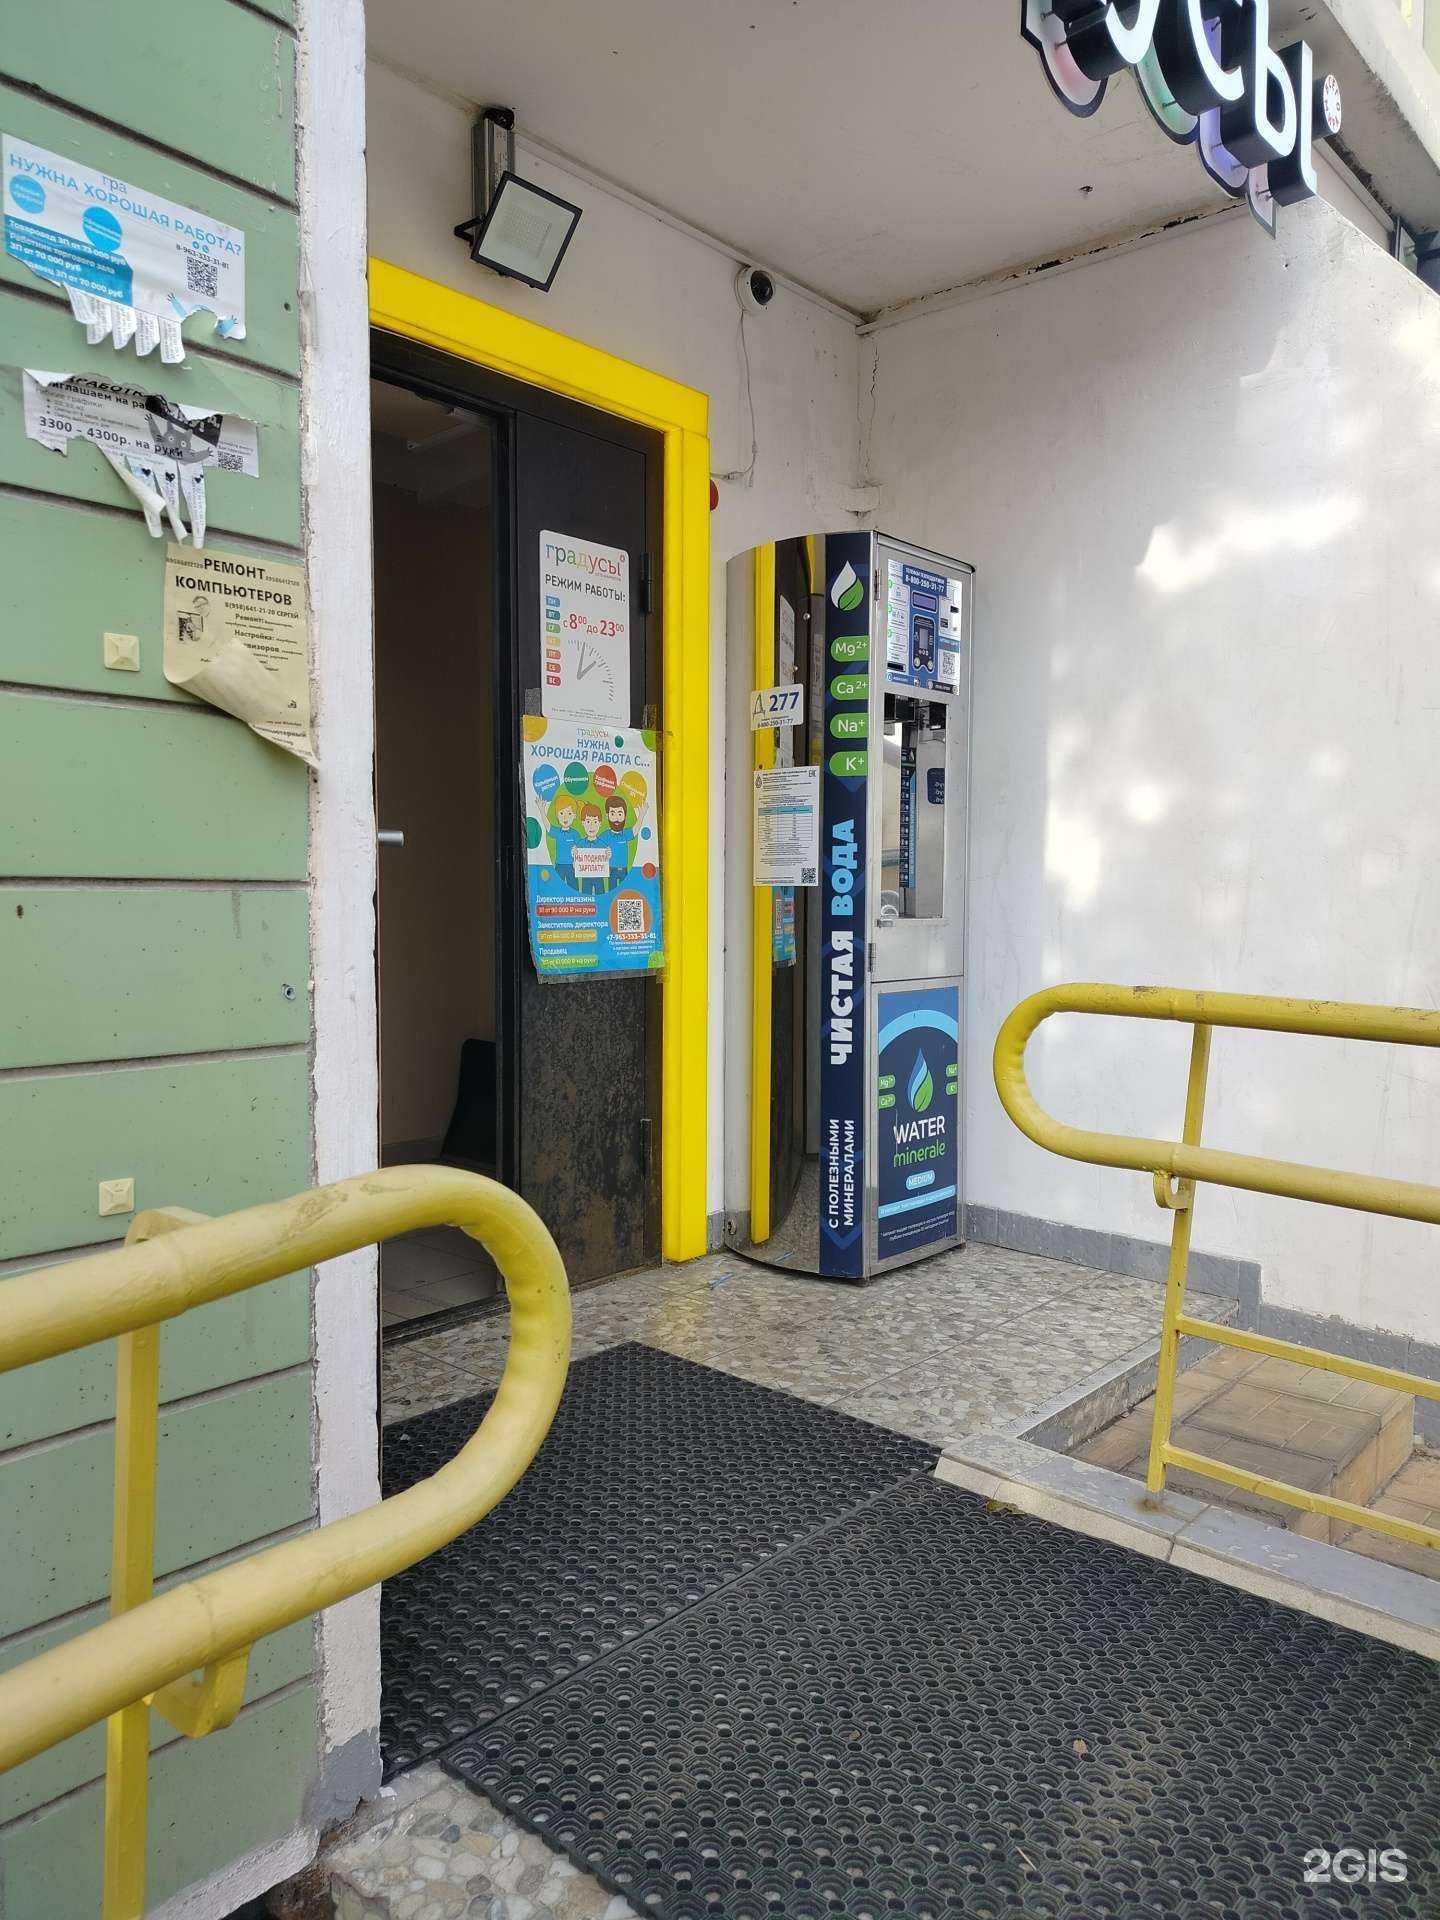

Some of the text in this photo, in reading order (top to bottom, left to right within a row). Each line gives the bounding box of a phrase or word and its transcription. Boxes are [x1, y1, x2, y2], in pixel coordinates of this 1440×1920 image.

[10, 154, 79, 191] НУЖНА
[84, 182, 170, 228] ХОРОШАЯ
[175, 220, 242, 256] РАБОТА?
[115, 393, 129, 406] на
[39, 415, 73, 433] 3300
[87, 426, 132, 447] 4300р.
[135, 438, 150, 450] на
[154, 441, 184, 460] руки
[204, 558, 266, 580] РЕМОНТ
[175, 575, 292, 606] КОМПЬЮТЕРОВ
[545, 573, 582, 592] РЕЖИМ
[585, 583, 626, 603] РАБОТЫ:
[769, 691, 800, 712] 277
[531, 745, 589, 761] ХОРОШАЯ
[591, 750, 632, 765] РАБОТА
[577, 739, 610, 751] НУЖНА
[830, 819, 858, 1066] ЧИСТАЯ ВОДА
[893, 1115, 946, 1145] WATER
[829, 1118, 840, 1216] ПОЛЕЗНЫМИ
[893, 1139, 946, 1168] minerale
[843, 1119, 855, 1227] МИНЕРАЛАМИ
